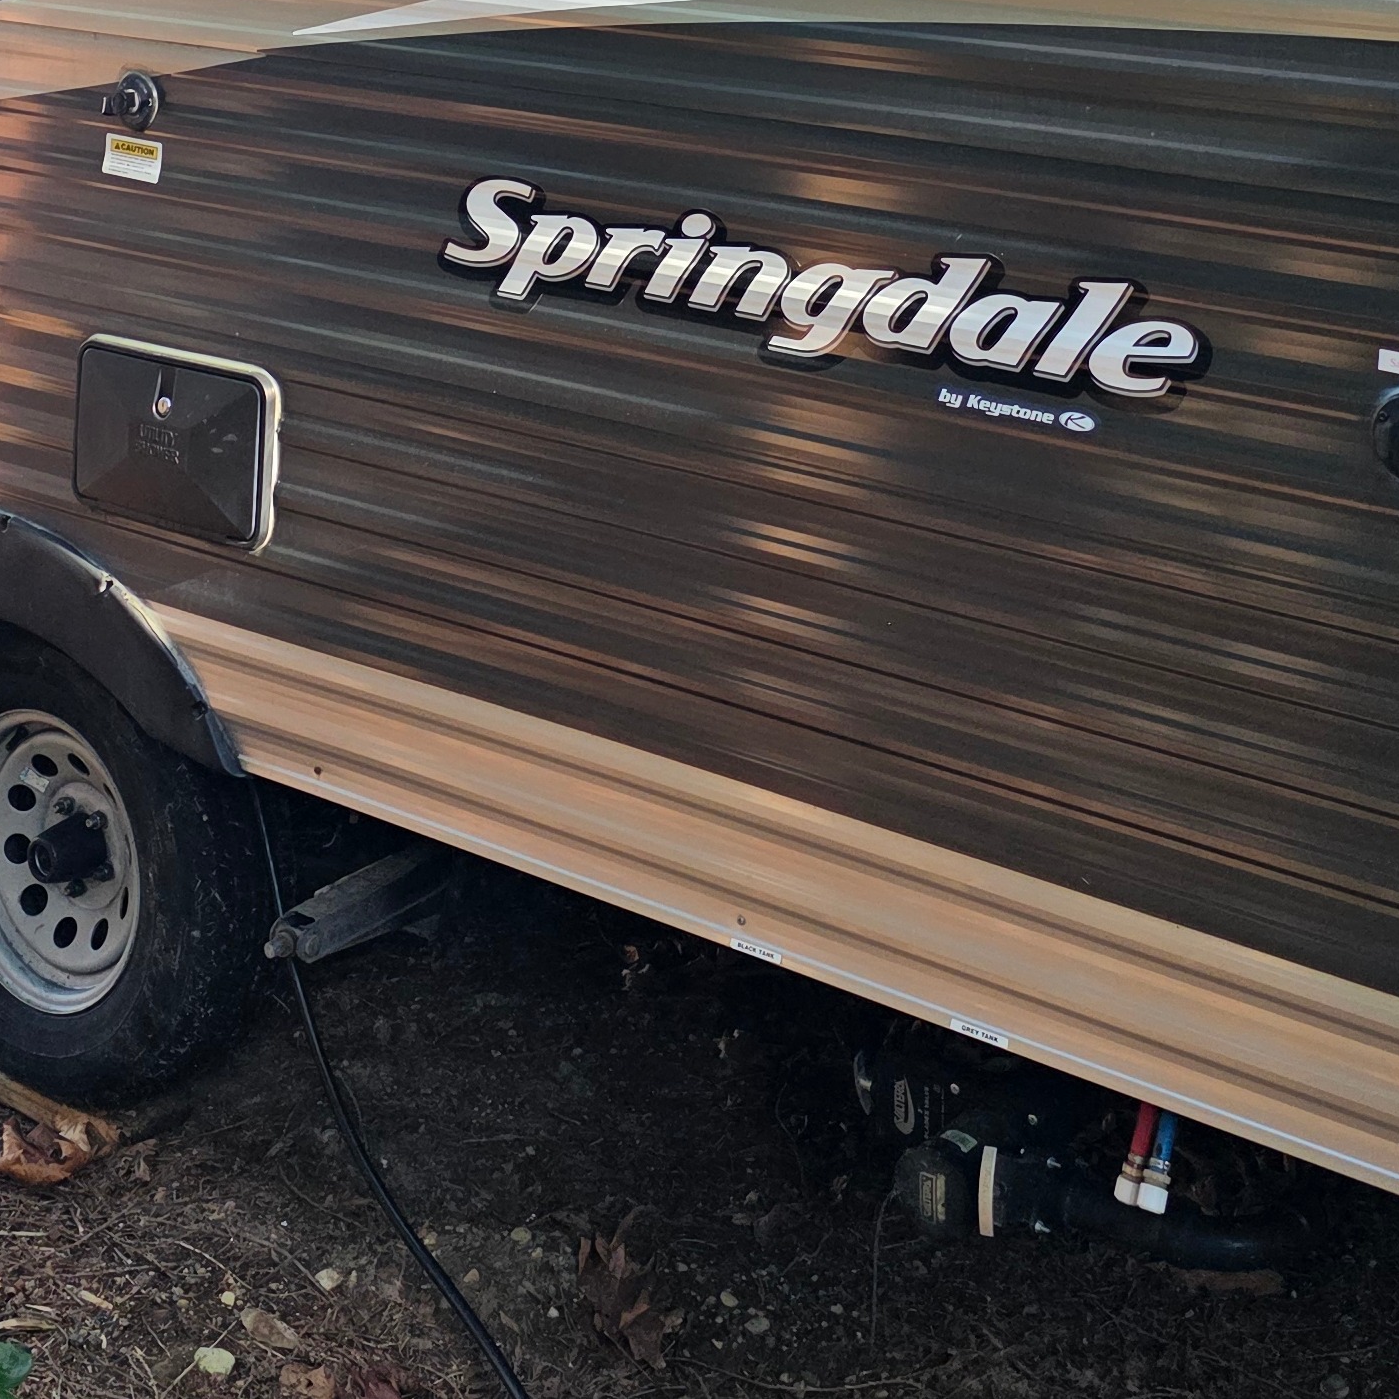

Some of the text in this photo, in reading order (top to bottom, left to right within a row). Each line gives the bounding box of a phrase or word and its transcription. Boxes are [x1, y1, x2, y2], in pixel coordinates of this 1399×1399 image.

[121, 143, 155, 156] CAUTION
[442, 178, 1201, 397] Springdale
[938, 388, 963, 409] by
[966, 394, 1055, 425] Keystone
[737, 942, 775, 960] BLACK TANK
[961, 1024, 999, 1043] GREY TANK
